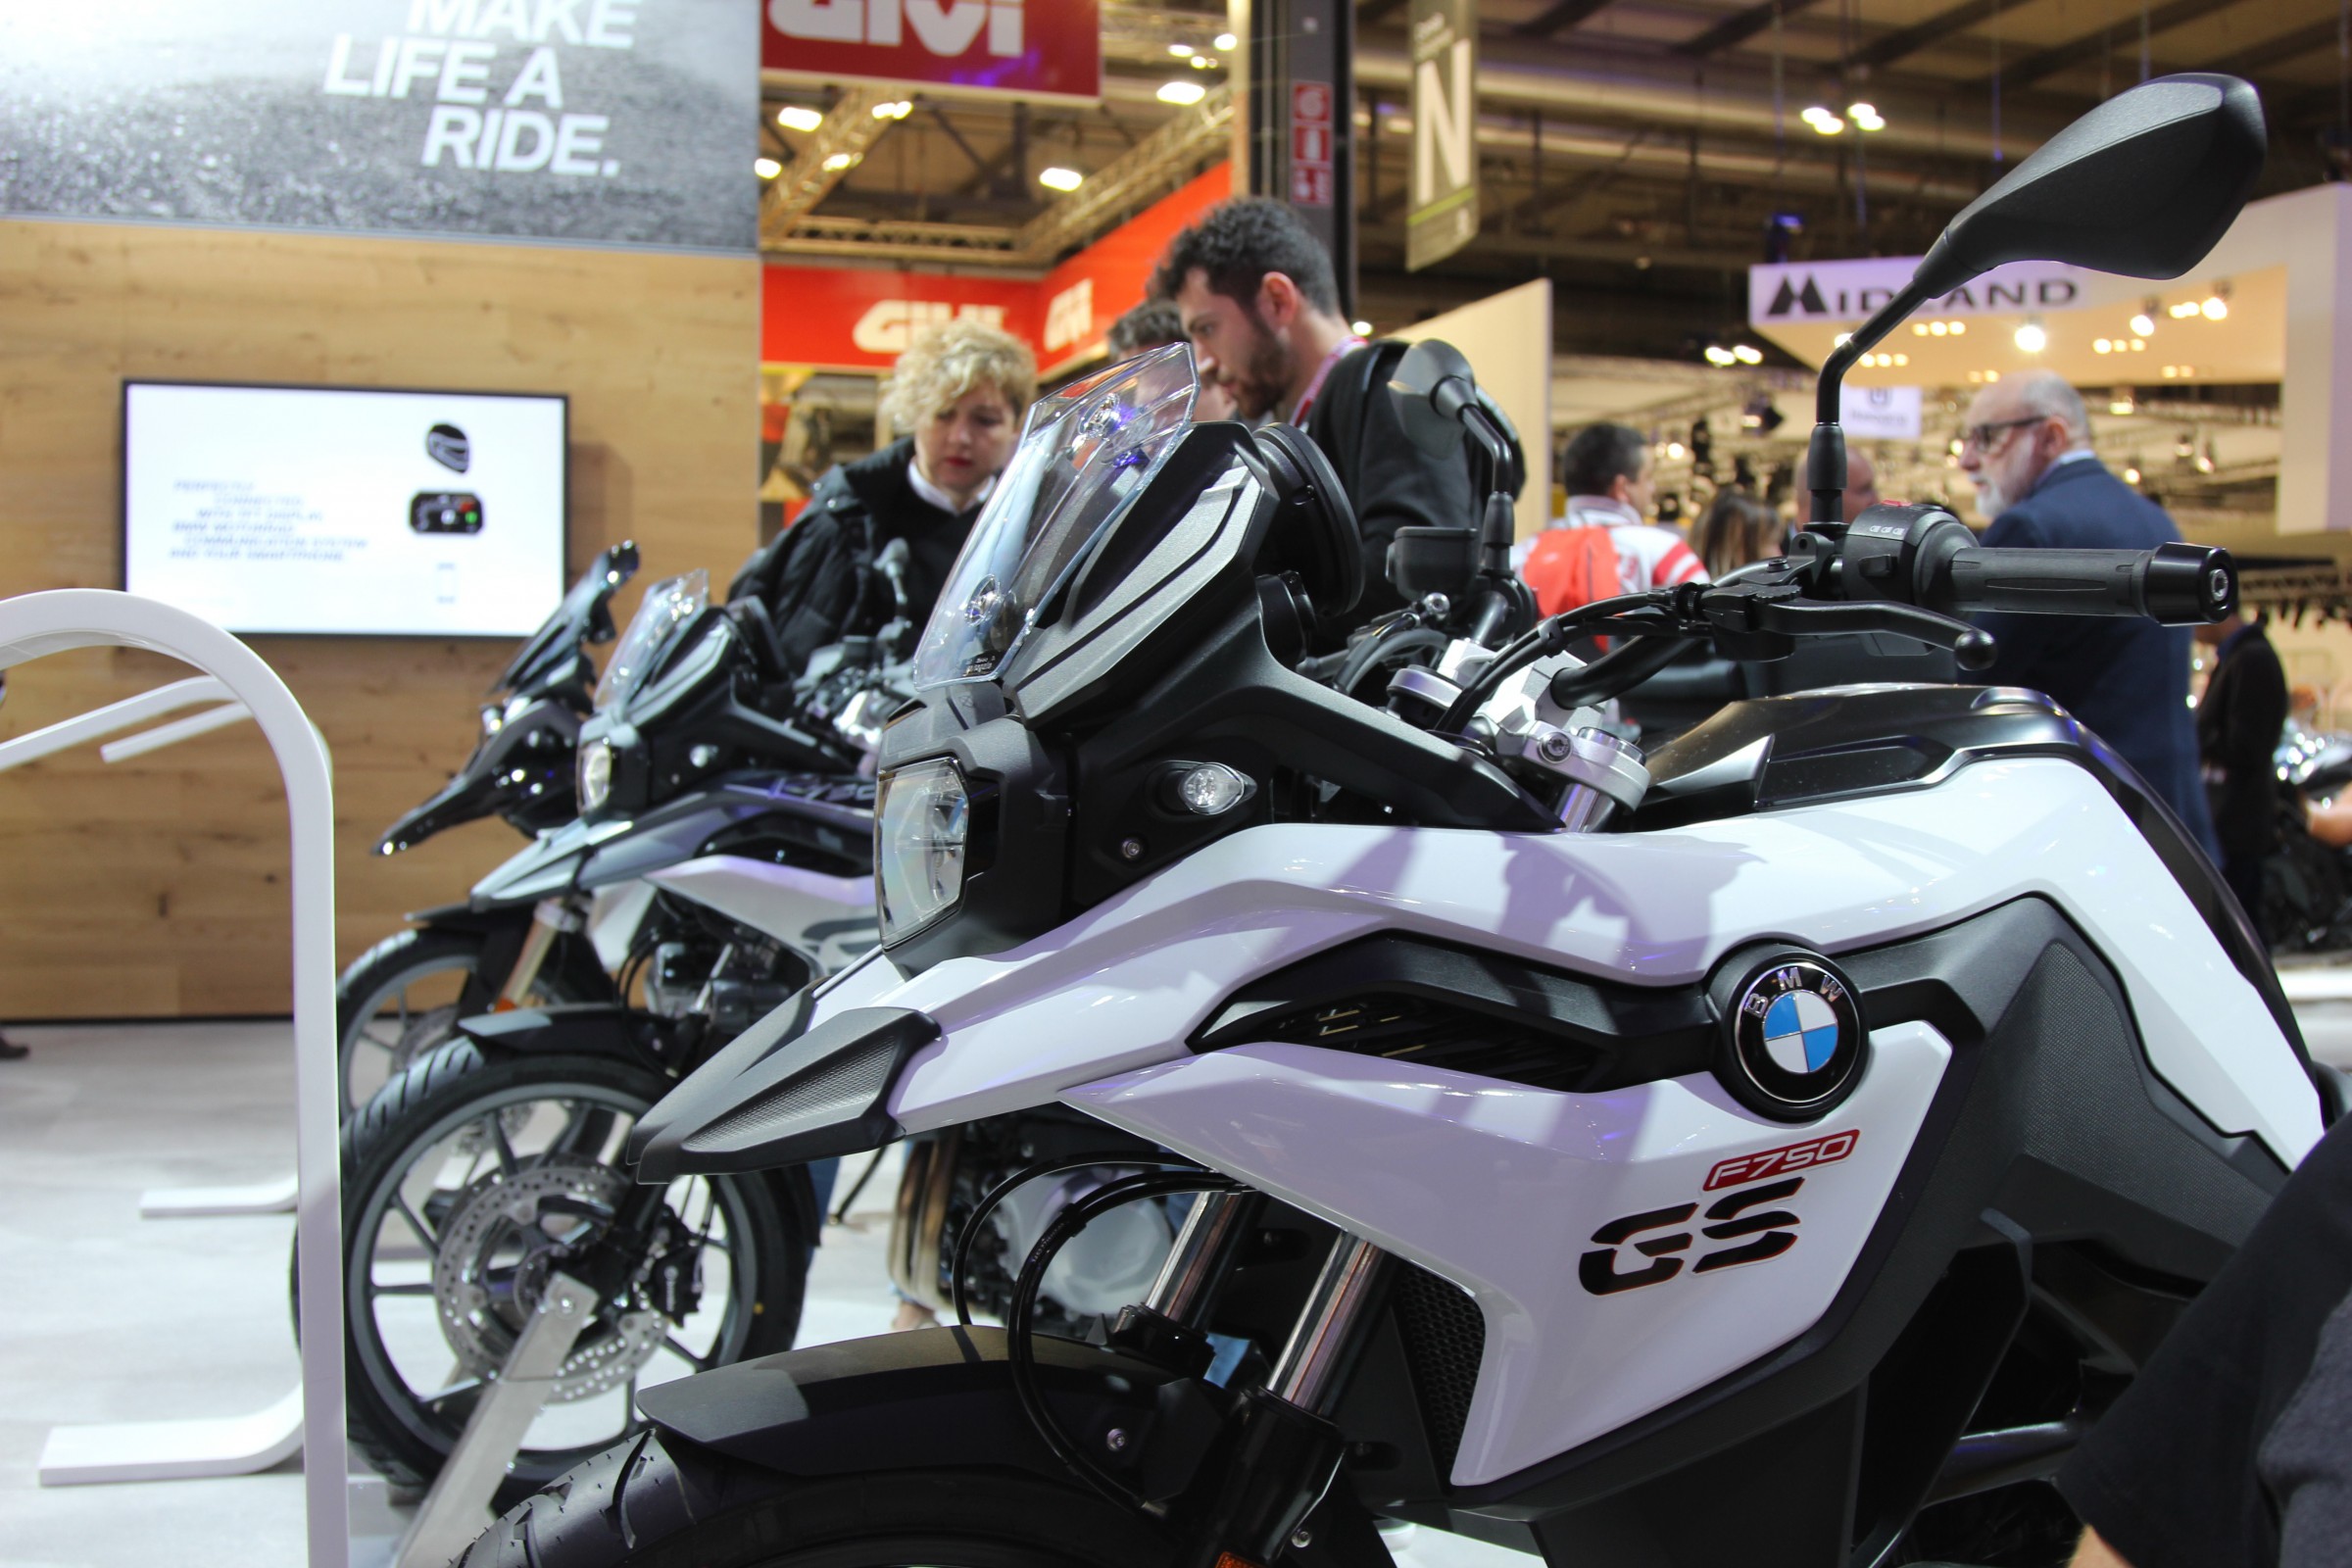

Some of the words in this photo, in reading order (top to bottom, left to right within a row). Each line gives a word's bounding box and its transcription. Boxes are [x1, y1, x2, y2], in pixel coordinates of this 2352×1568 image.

[405, 0, 637, 49] MAKE
[321, 32, 498, 105] LIFE
[503, 46, 564, 110] A
[419, 104, 621, 178] RIDE.
[1417, 37, 1471, 206] N
[1766, 272, 2079, 316] MIDAND
[1743, 966, 1844, 1019] BMW
[1707, 1133, 1855, 1189] F750
[1578, 1176, 1806, 1297] GS
